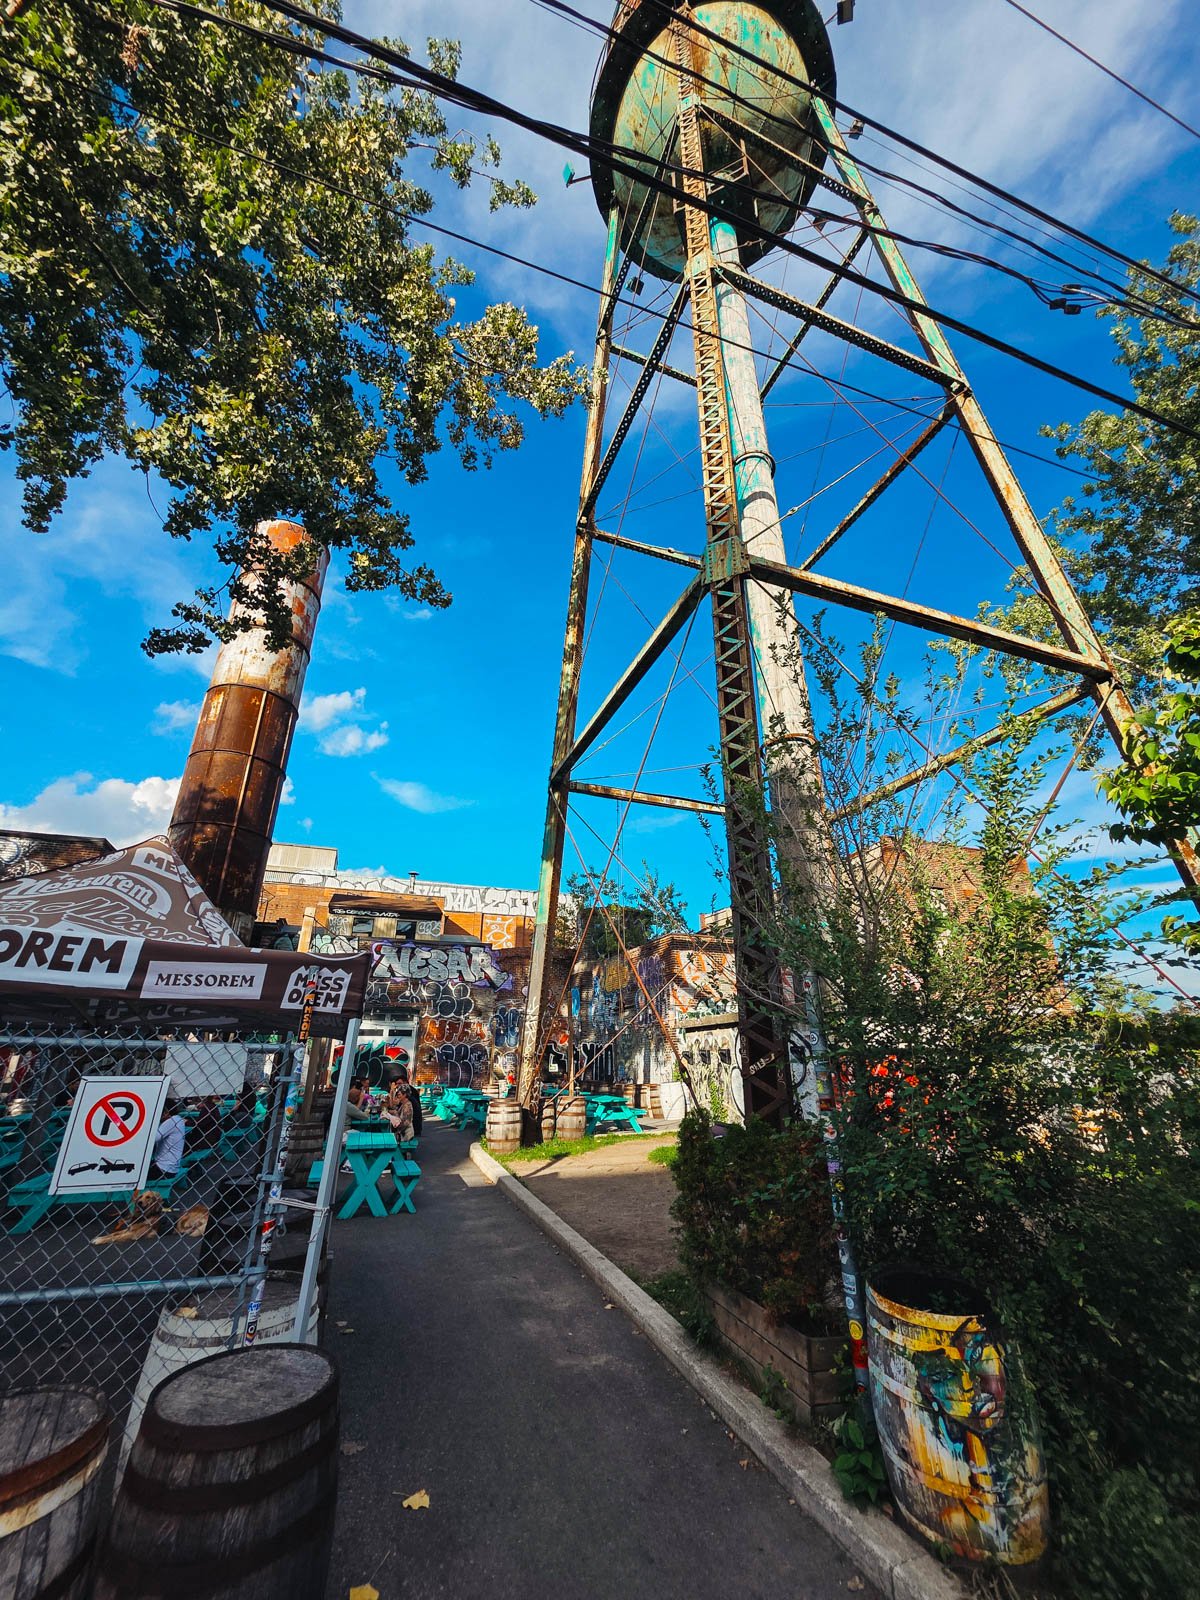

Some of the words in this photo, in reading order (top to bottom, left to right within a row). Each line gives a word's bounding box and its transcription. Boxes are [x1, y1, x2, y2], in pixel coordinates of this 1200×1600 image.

[154, 972, 255, 988] MESSOREM
[294, 972, 345, 993] MSS
[288, 988, 341, 1009] OEM
